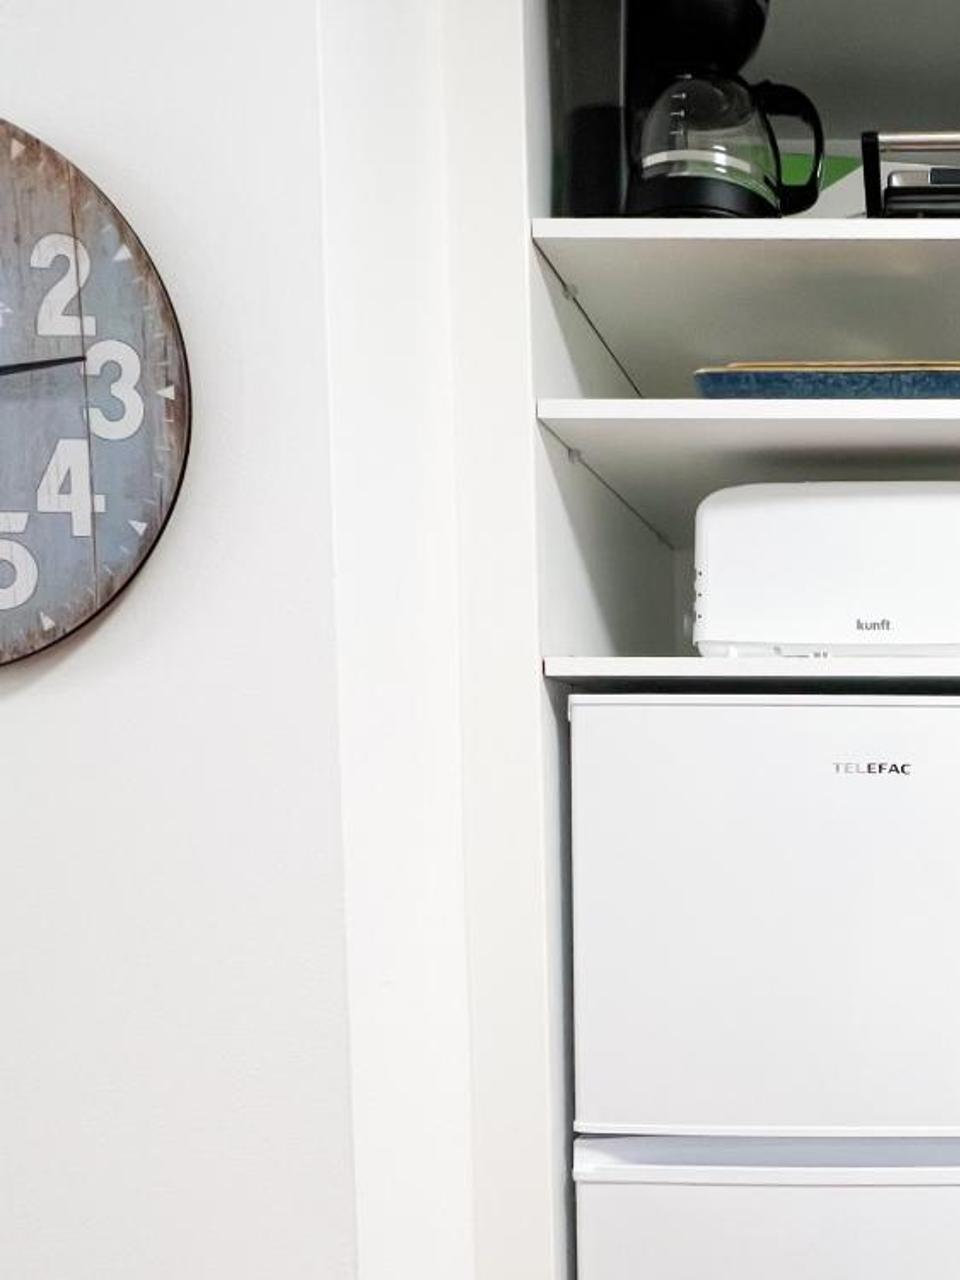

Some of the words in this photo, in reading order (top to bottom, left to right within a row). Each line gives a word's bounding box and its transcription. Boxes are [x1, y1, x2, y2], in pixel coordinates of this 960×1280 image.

[30, 233, 96, 336] 2
[82, 340, 144, 440] 3
[37, 438, 106, 536] 4
[856, 619, 890, 631] kunft
[832, 762, 911, 775] TELEFAC
